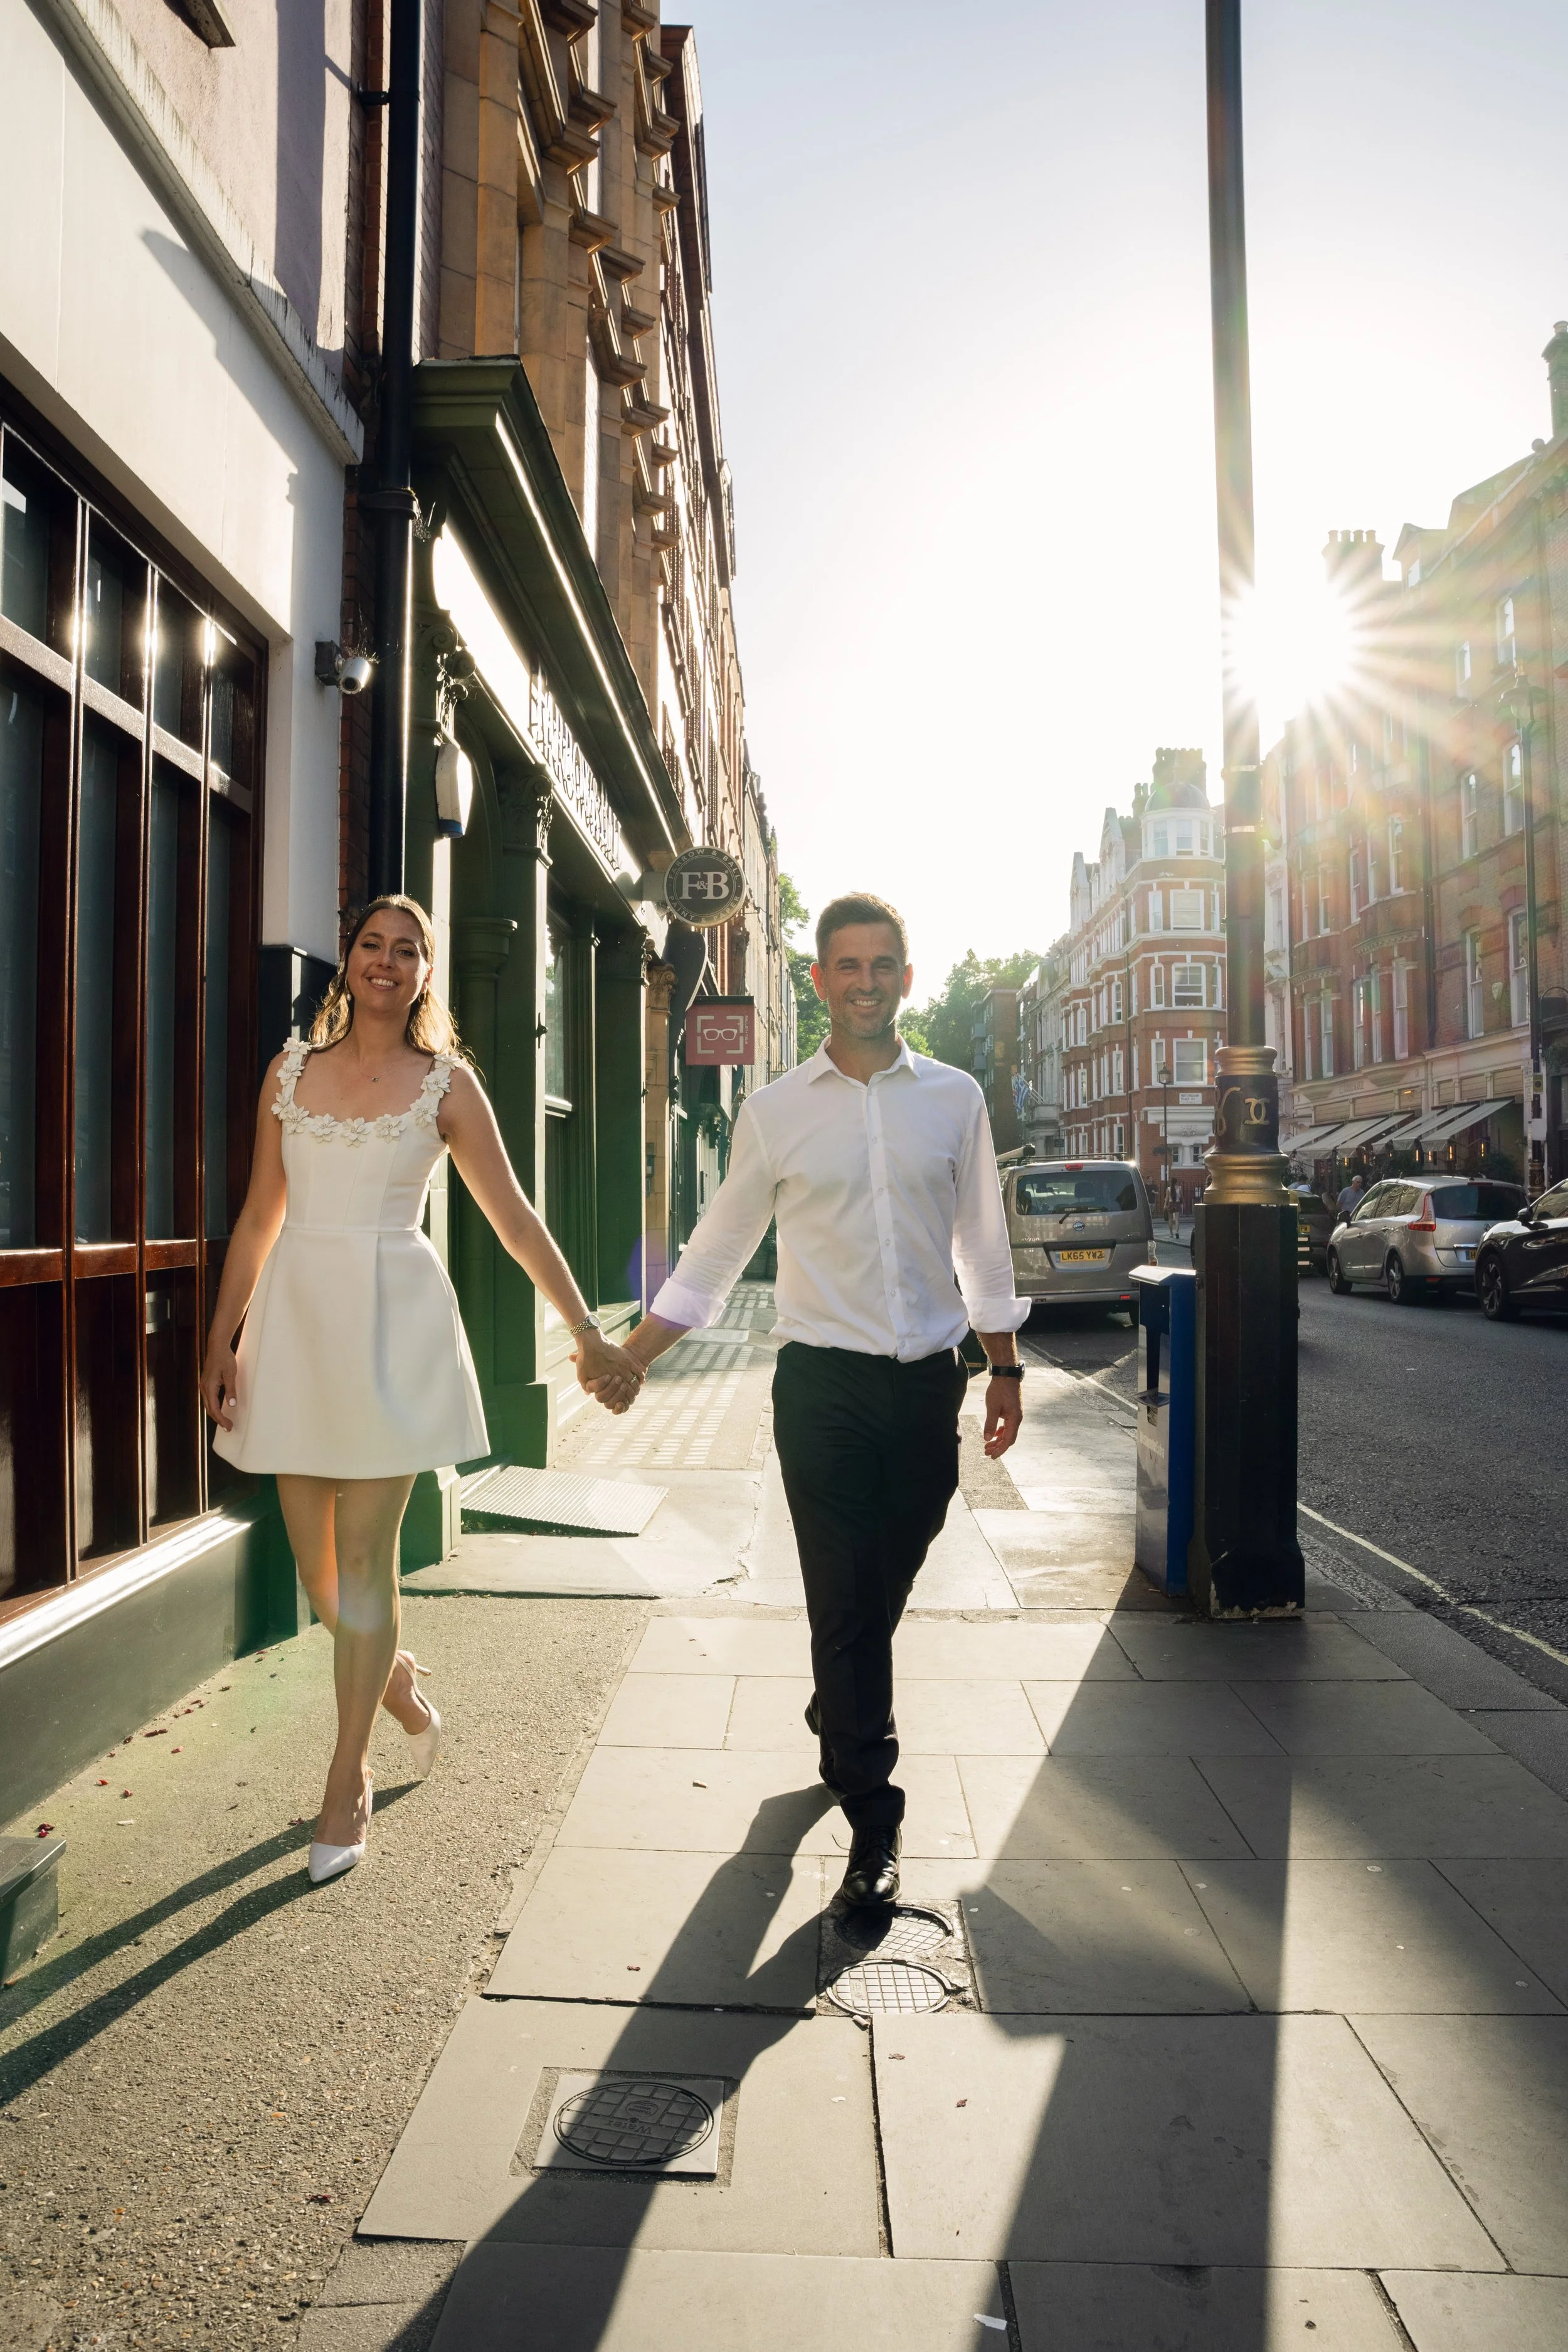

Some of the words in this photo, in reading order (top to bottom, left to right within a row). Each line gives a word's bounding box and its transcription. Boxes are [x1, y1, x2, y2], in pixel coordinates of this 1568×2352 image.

[669, 849, 705, 879] FARROW
[723, 856, 740, 879] BALL
[679, 871, 729, 899] F&B
[669, 896, 695, 921] PAINT
[713, 896, 740, 921] PAPER
[1061, 1251, 1084, 1261] LK65
